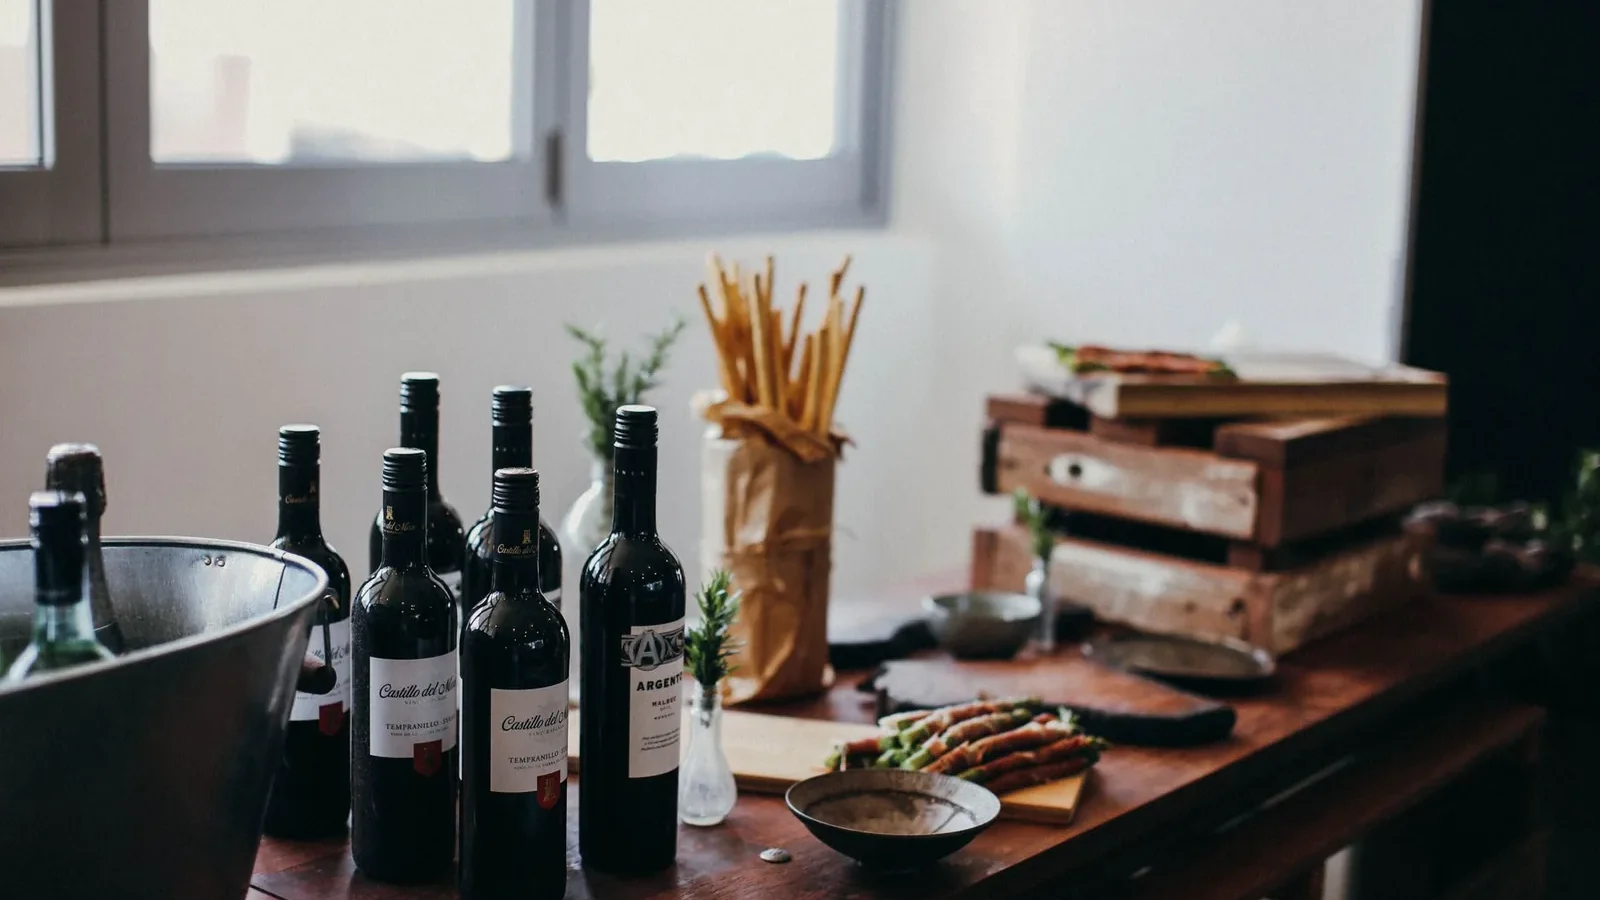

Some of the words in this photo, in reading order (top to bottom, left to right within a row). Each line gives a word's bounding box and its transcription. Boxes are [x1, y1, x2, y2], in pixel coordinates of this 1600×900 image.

[634, 631, 660, 667] A
[379, 683, 420, 699] Castillo
[421, 682, 440, 697] del
[386, 721, 440, 731] TEMPRANILLO
[501, 715, 543, 732] Castillo
[544, 710, 560, 728] del
[509, 751, 559, 764] TEMPRANILLO
